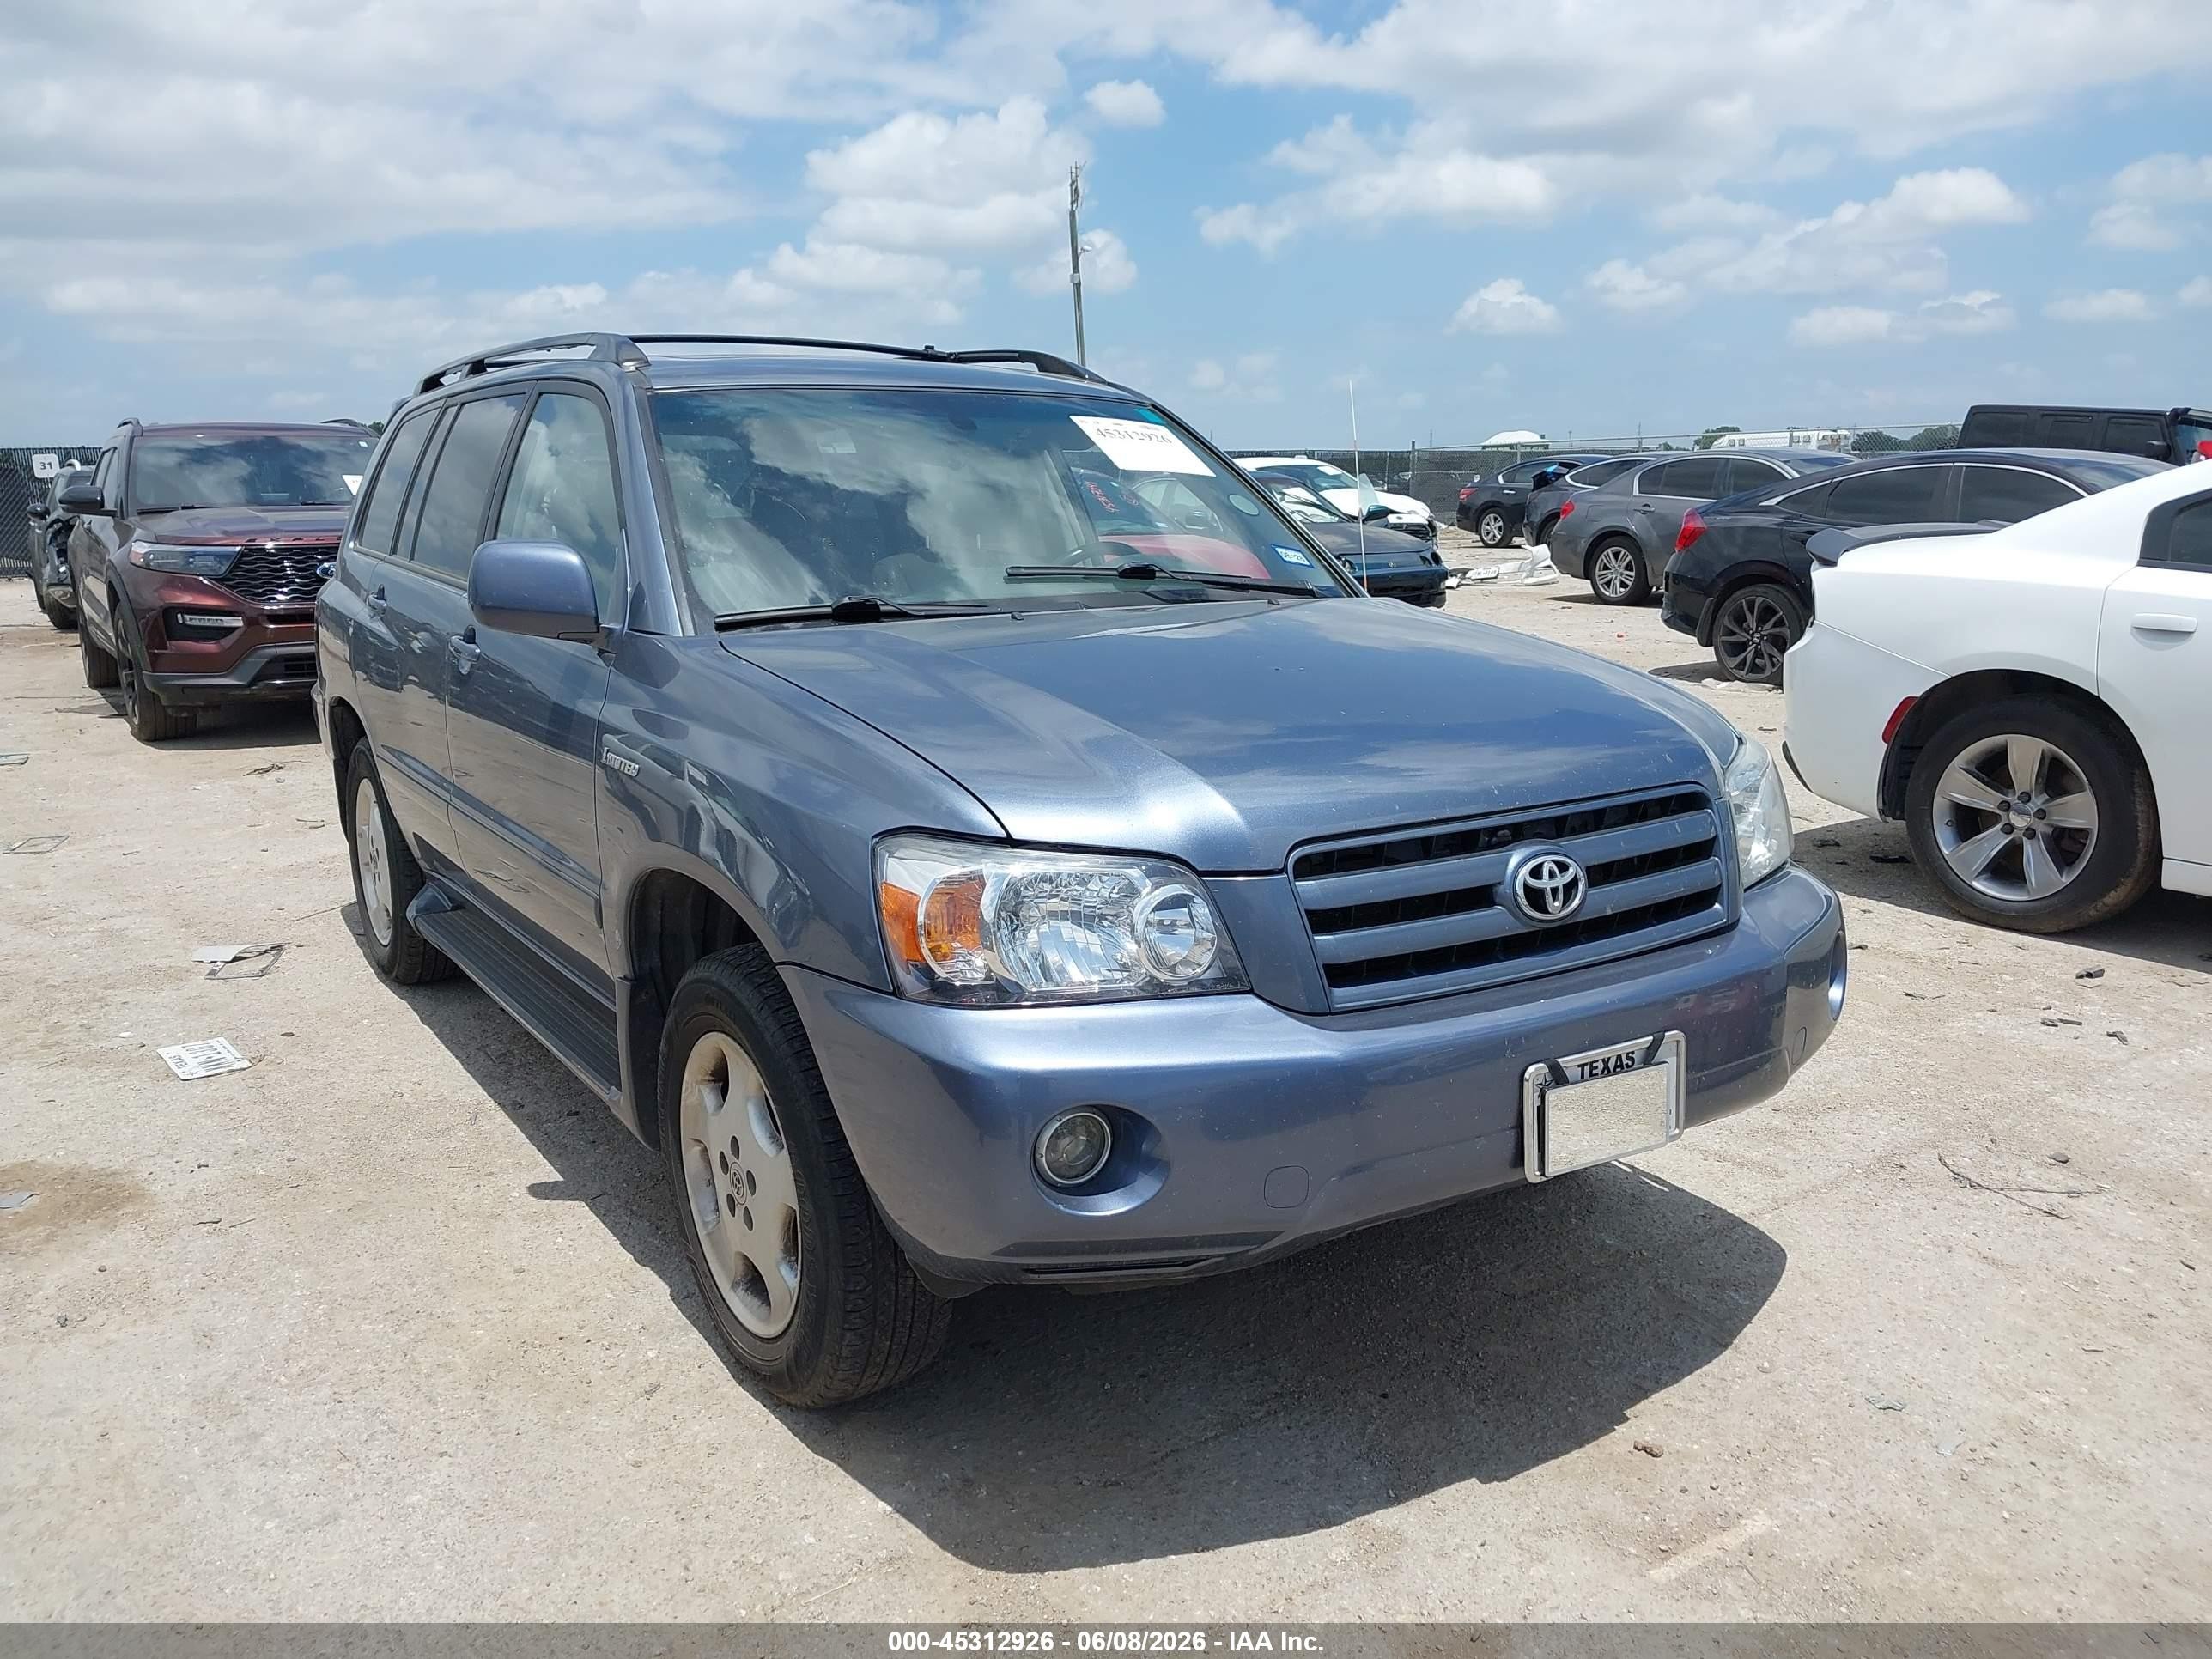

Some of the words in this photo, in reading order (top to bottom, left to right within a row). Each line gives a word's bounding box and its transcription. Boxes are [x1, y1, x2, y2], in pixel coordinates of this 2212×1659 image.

[1096, 428, 1172, 444] 45312926
[40, 461, 53, 471] 31
[1577, 1051, 1636, 1080] TEXAS
